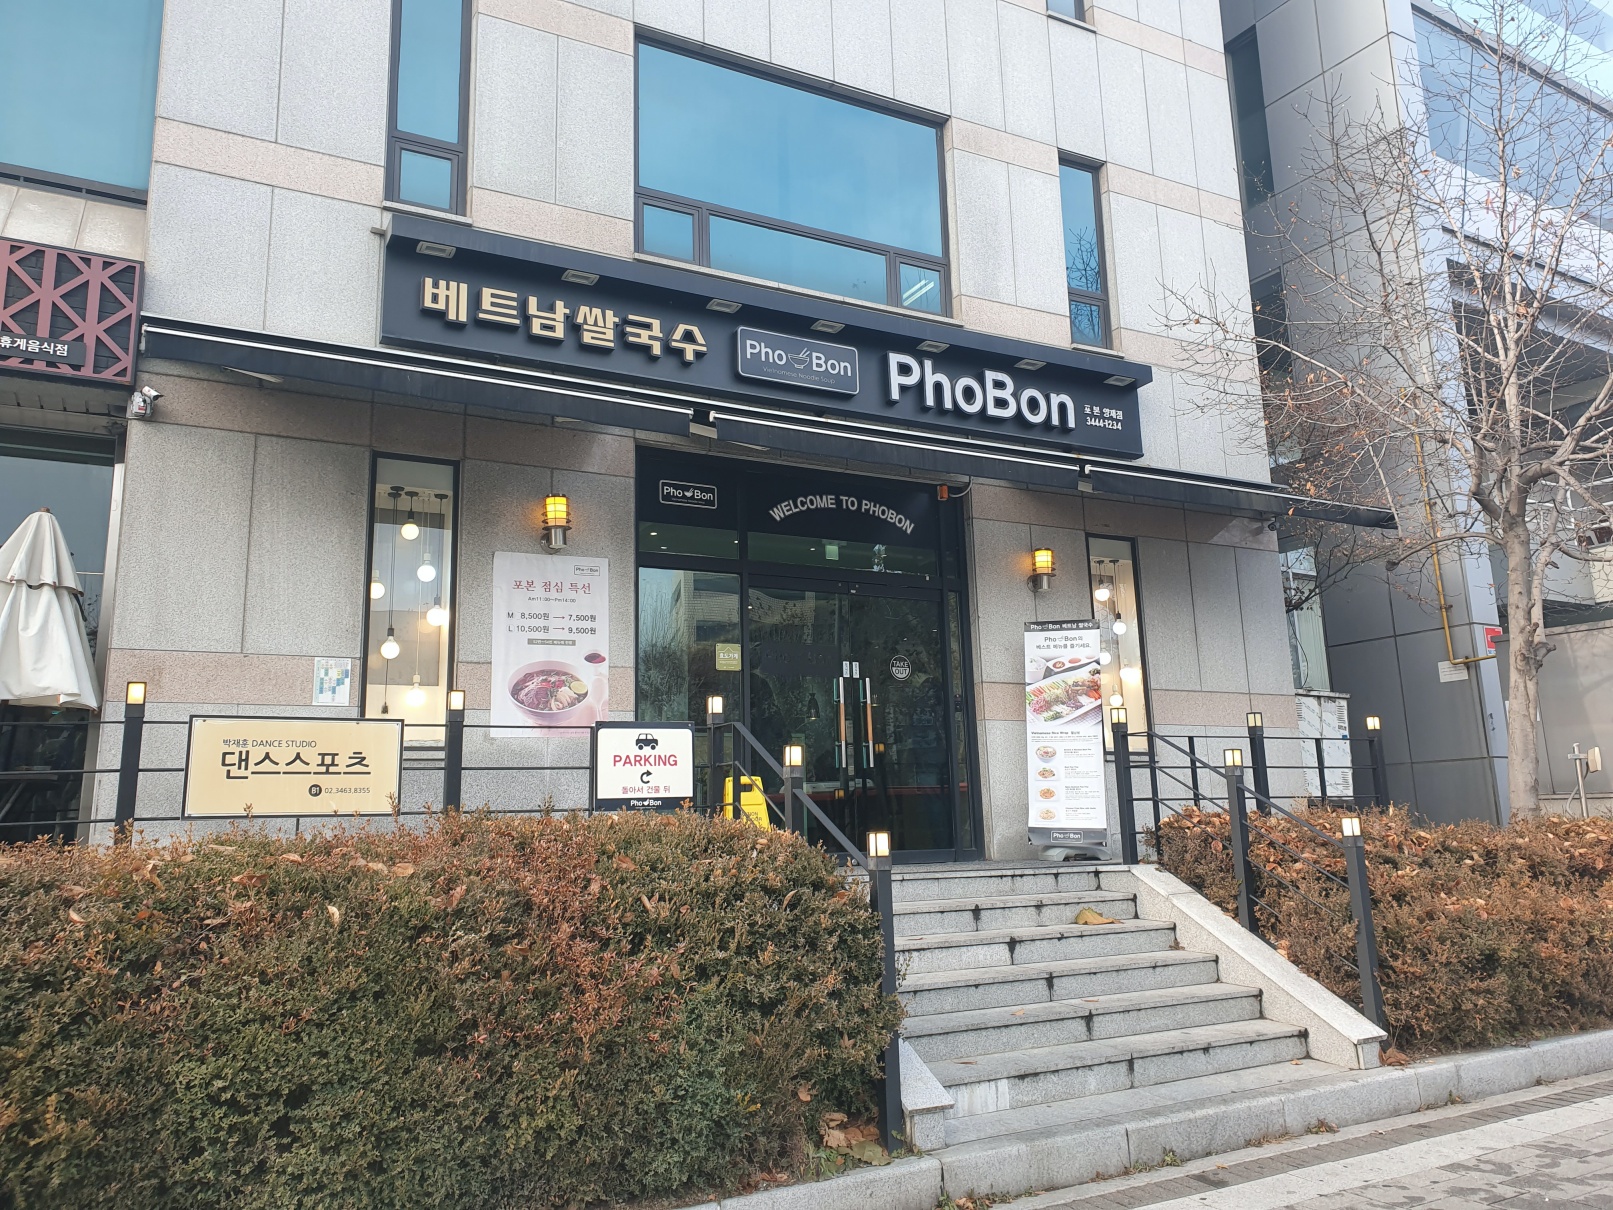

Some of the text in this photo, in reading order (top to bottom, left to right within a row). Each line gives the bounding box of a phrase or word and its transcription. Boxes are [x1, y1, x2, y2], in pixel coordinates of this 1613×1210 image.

[422, 275, 709, 363] 베트남쌀국수
[0, 335, 68, 357] 휴게음식점
[745, 339, 852, 377] Pho Bon
[762, 365, 798, 378] Vietnamese
[886, 350, 1076, 430] PhoBon
[1093, 405, 1101, 416] 본
[1102, 408, 1123, 420] 양재점
[1086, 416, 1122, 431] 3444-1234
[663, 485, 683, 497] Pho
[694, 489, 713, 501] Bon
[768, 494, 915, 535] WELCOME TO PHOBON
[512, 579, 592, 595] 포본 점심 특선
[520, 612, 550, 621] 8,500원
[568, 614, 597, 622] 7,500원
[516, 625, 550, 634] 10,500원
[567, 627, 597, 635] 9,500원
[892, 660, 909, 668] TAKE
[222, 738, 317, 749] 박재훈 DANCE STUDIO
[220, 749, 372, 780] 댄스스포츠
[613, 754, 678, 767] PARKING
[621, 785, 671, 794] 돌아서 건물 뒤
[630, 799, 643, 807] Pho
